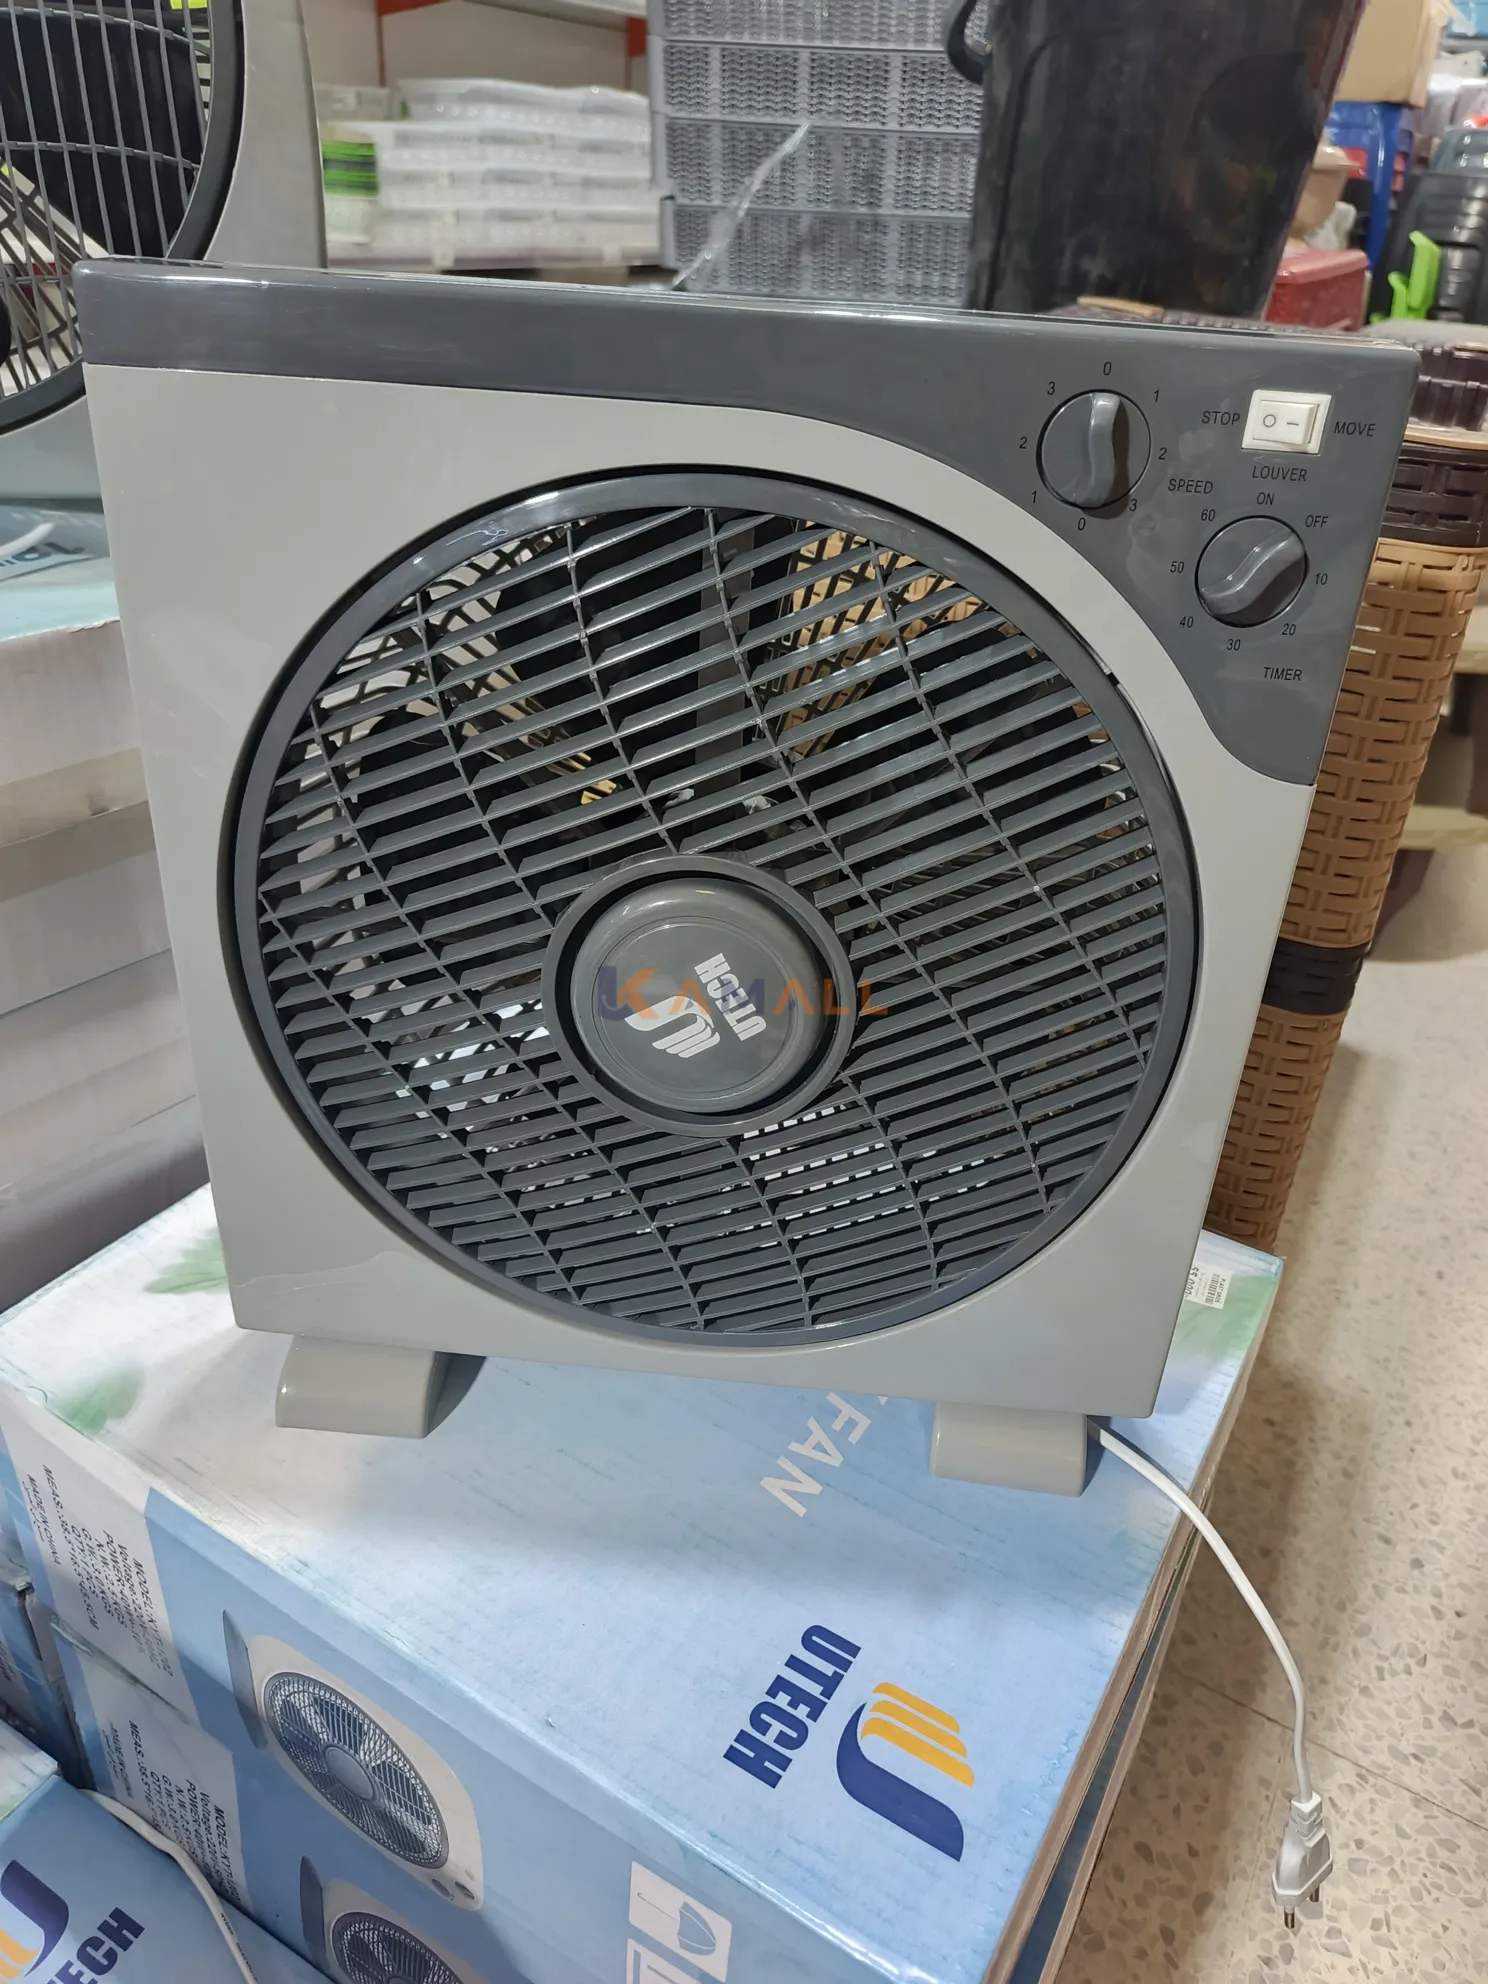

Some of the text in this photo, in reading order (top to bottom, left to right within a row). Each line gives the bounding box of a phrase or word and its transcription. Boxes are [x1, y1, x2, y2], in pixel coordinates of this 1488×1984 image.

[1103, 362, 1112, 376] 0
[1047, 381, 1056, 395] 3
[1153, 390, 1160, 403] 1
[1201, 410, 1241, 426] STOP
[1334, 421, 1375, 437] MOVE
[1019, 436, 1028, 450] 2
[1158, 447, 1167, 460] 2
[1252, 465, 1307, 482] LOUVER
[1167, 478, 1213, 495] SPEED
[1031, 490, 1037, 504] 1
[1256, 491, 1275, 506] ON
[1129, 498, 1138, 512] 3
[1200, 508, 1216, 522] 60
[1304, 514, 1328, 529] OFF
[1077, 517, 1086, 531] 0
[1170, 560, 1185, 574] 50
[1315, 573, 1328, 586] 10
[1179, 615, 1194, 629] 40
[1281, 623, 1296, 636] 20
[1226, 638, 1241, 652] 30
[1263, 666, 1303, 682] TIMER
[693, 952, 767, 1042] UTECH
[760, 1392, 871, 1518] FAN
[723, 1625, 861, 1789] UTECH
[46, 1907, 145, 1984] ECH
